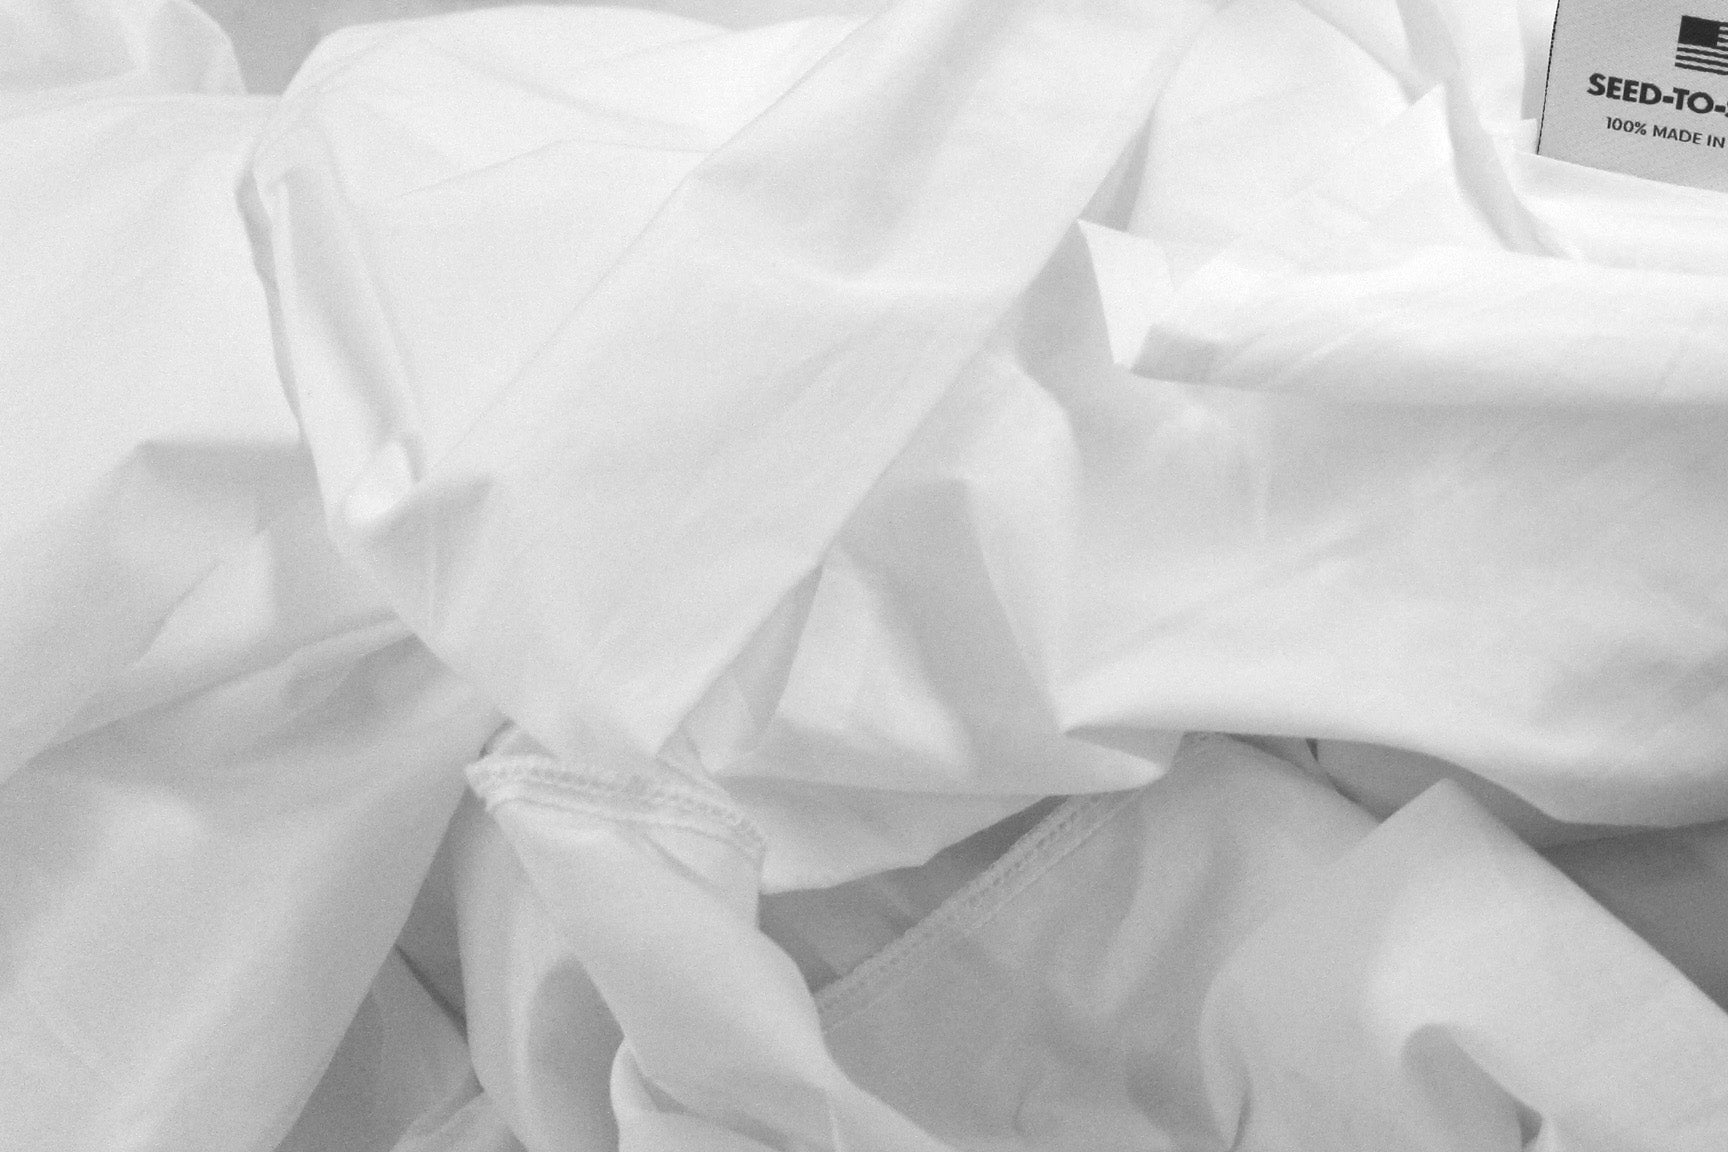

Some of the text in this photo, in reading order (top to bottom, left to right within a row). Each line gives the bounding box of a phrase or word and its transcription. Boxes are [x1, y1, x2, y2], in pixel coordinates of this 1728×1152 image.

[1605, 116, 1647, 136] 100%
[1652, 124, 1702, 145] MADE
[1706, 134, 1725, 149] IN
